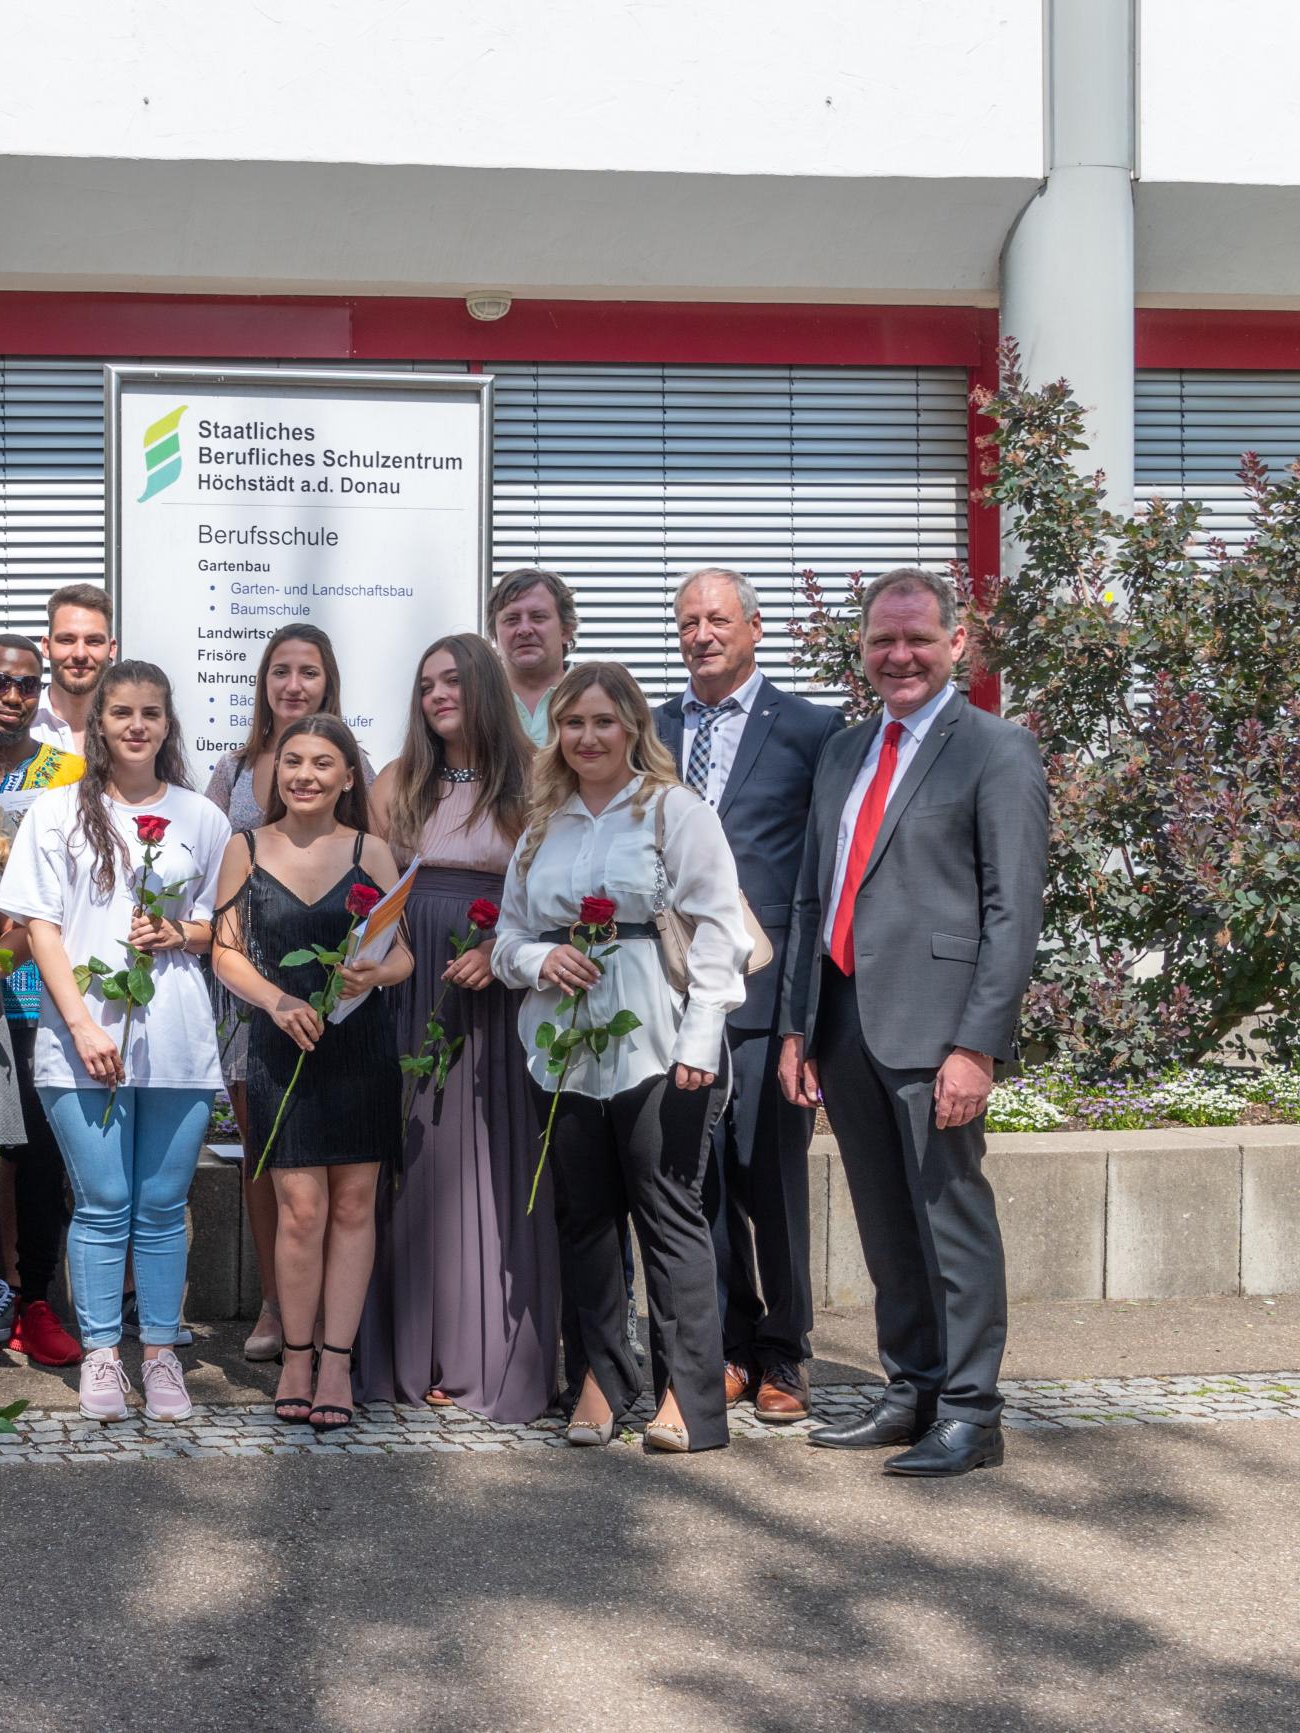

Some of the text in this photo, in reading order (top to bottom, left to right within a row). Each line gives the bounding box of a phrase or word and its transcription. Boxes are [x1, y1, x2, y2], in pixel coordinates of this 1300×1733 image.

[198, 420, 315, 441] Staatliches
[198, 446, 463, 471] Berufliches Schulzentrum
[198, 473, 401, 495] Höchstädt a.d. Donau
[198, 524, 339, 547] Berufsschule
[198, 559, 271, 573] Gartenbau
[230, 582, 413, 598] Garten- und Landschaftsbau
[230, 603, 311, 617] Baumschule
[198, 649, 247, 662] Frisöre
